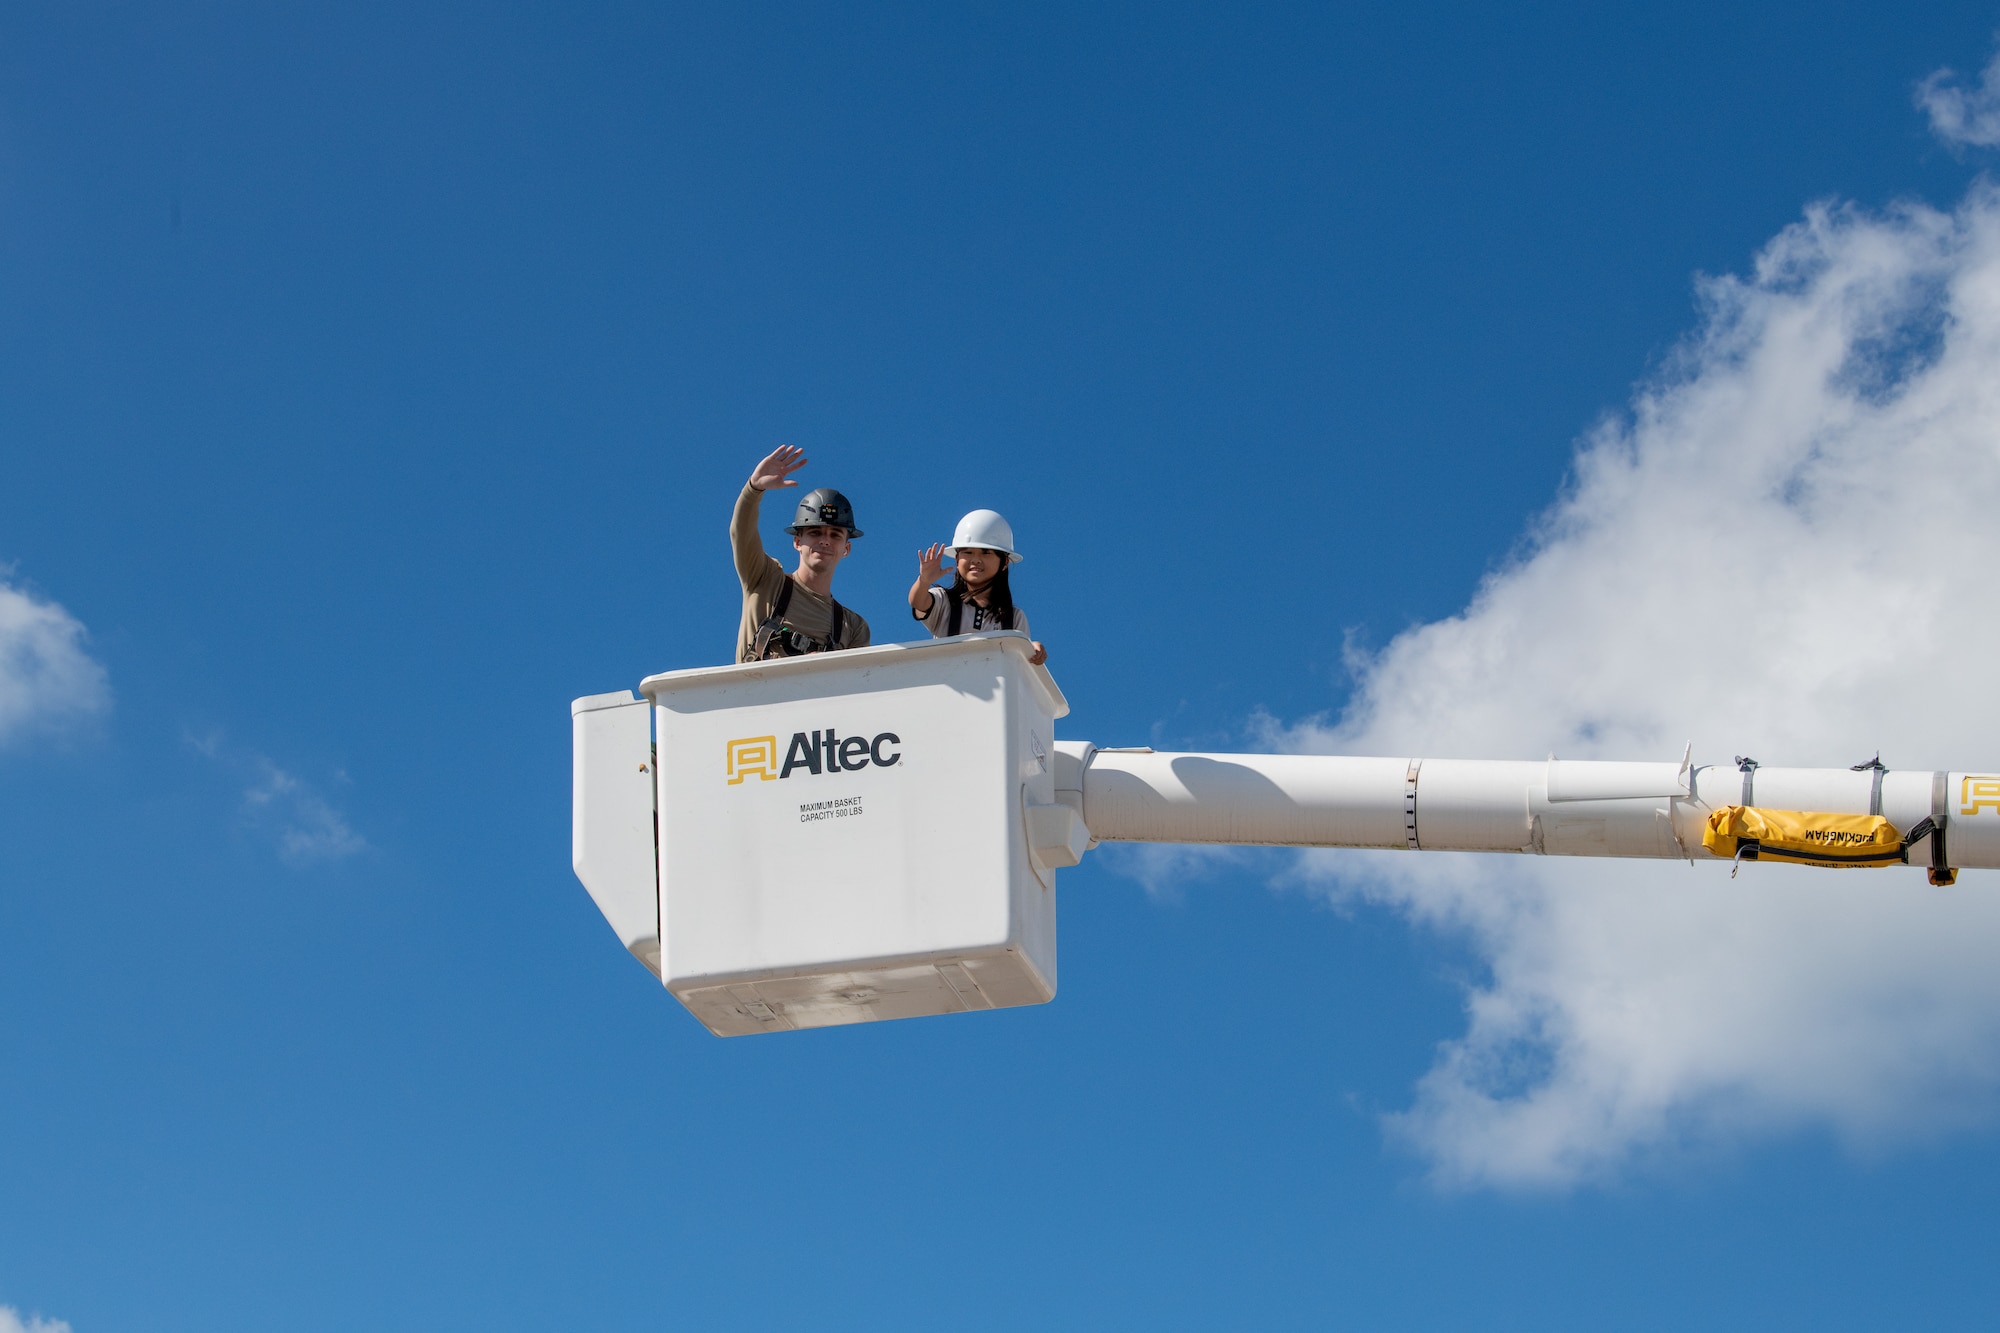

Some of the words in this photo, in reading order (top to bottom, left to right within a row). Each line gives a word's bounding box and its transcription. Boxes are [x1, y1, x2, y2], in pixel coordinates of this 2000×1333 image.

[779, 728, 901, 779] Altec
[800, 801, 833, 812] MAXIMUM
[834, 796, 862, 808] BASKET
[800, 810, 835, 823] CAPACITY
[836, 808, 848, 818] 500
[849, 806, 863, 816] LBS
